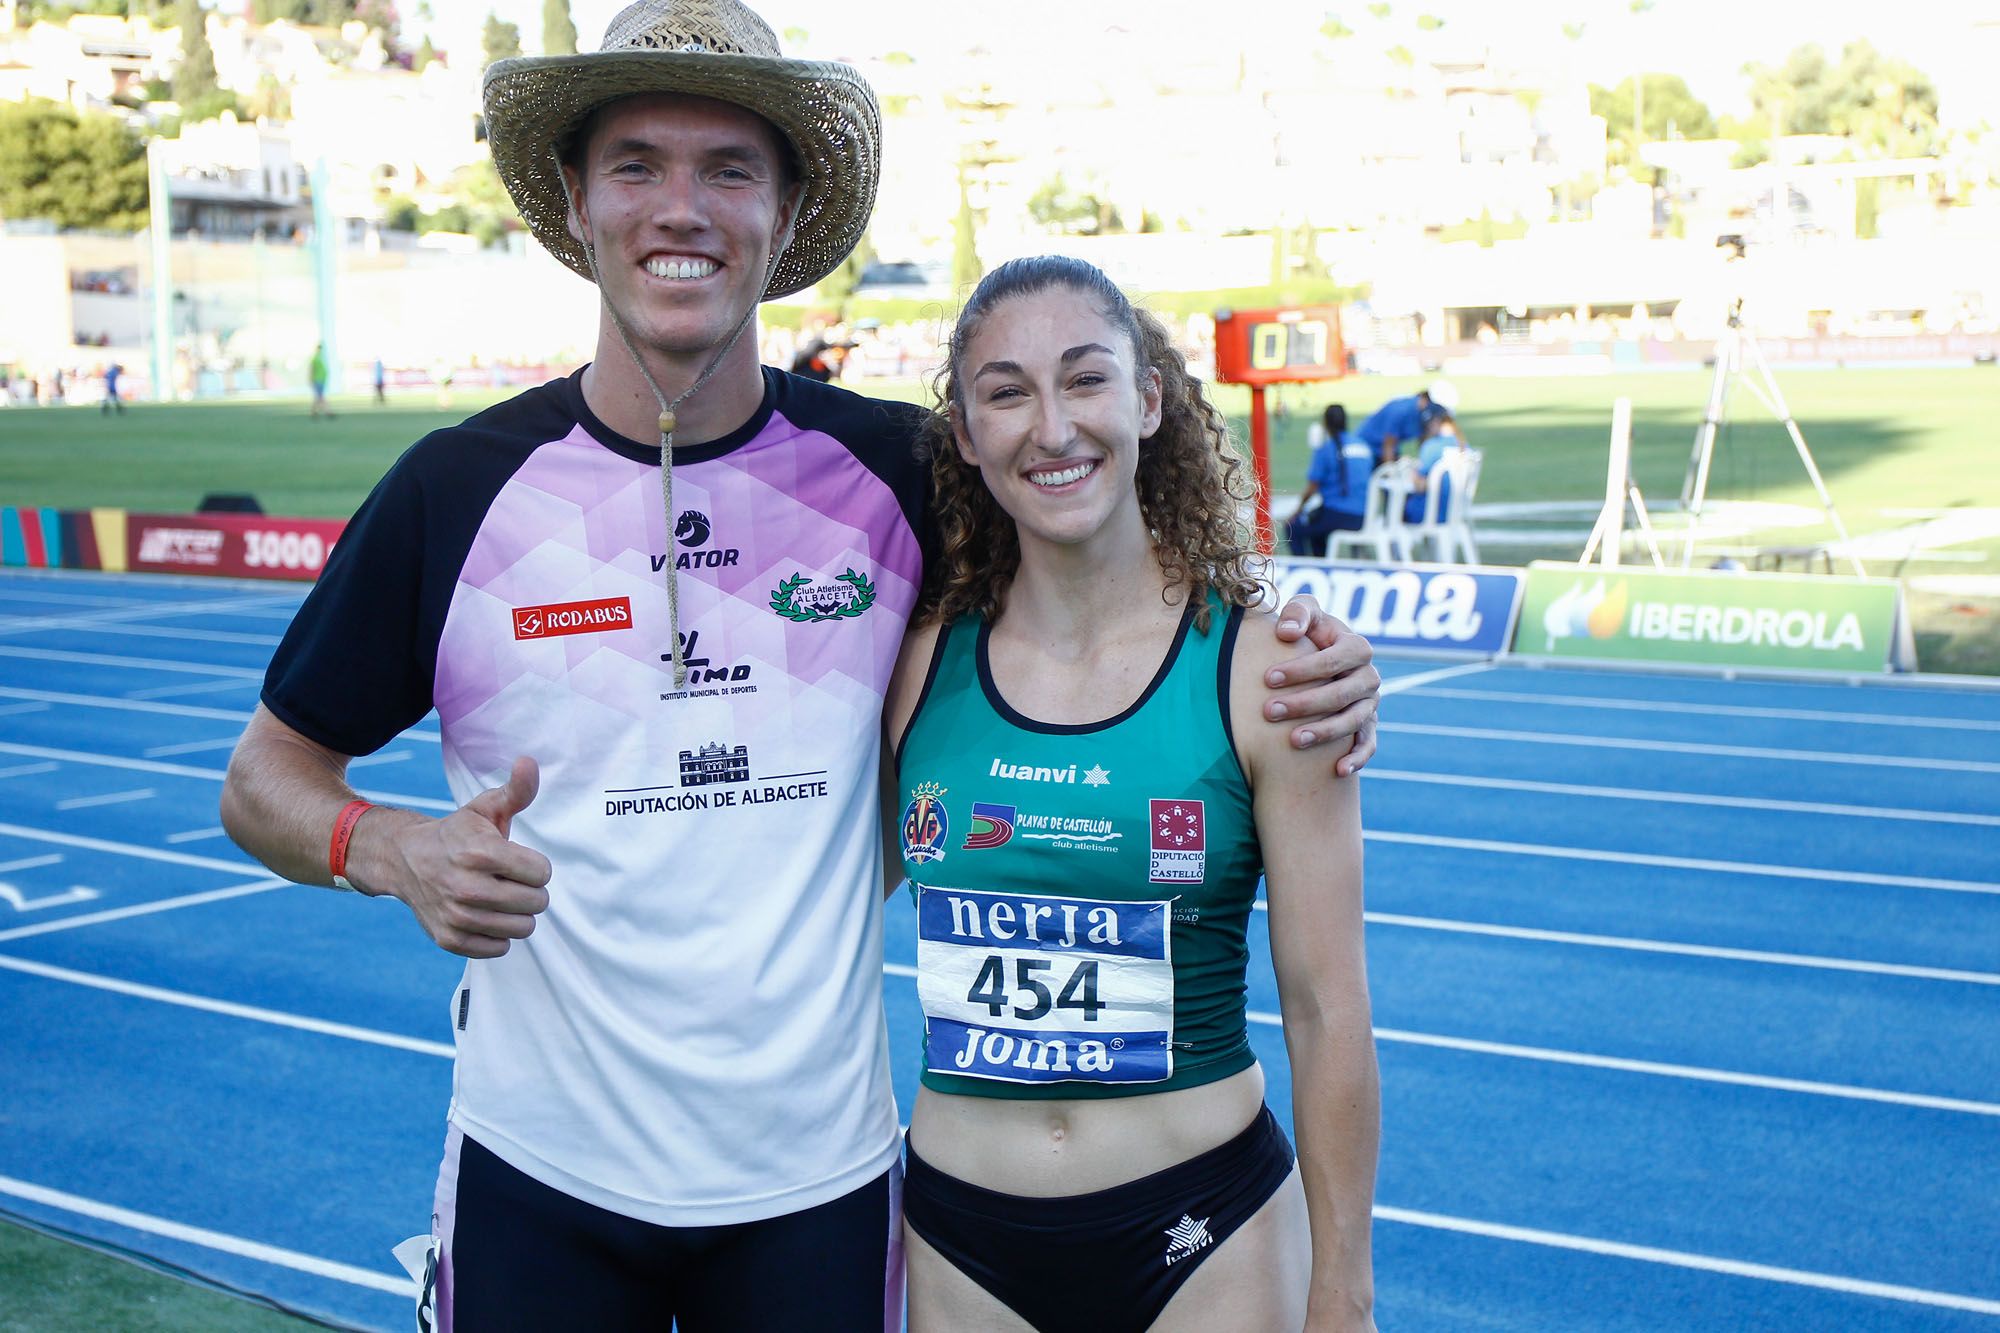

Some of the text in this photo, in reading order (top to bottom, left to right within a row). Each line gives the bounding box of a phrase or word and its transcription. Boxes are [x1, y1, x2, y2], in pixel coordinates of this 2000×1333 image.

[244, 530, 324, 570] 3000
[650, 548, 740, 572] VATOR
[796, 584, 854, 595] Club Atletismo
[797, 591, 854, 603] ALBACETE
[1277, 566, 1483, 641] oma
[547, 605, 628, 629] RODABUS
[1629, 601, 1864, 651] IBERDROLA
[660, 685, 758, 701] INSTITUTO MUNICIPAL DE DEPORTES
[989, 758, 1077, 784] luanvi
[605, 781, 828, 816] DIPUTACIÓN DE ALBACETE
[1017, 813, 1112, 834] PLAYAS DE CASTELLÓN
[1052, 840, 1119, 853] club atletisme
[1152, 851, 1204, 861] DIPUTACIÓ
[1150, 869, 1203, 878] CASTELLÓ
[967, 955, 1106, 1022] 454
